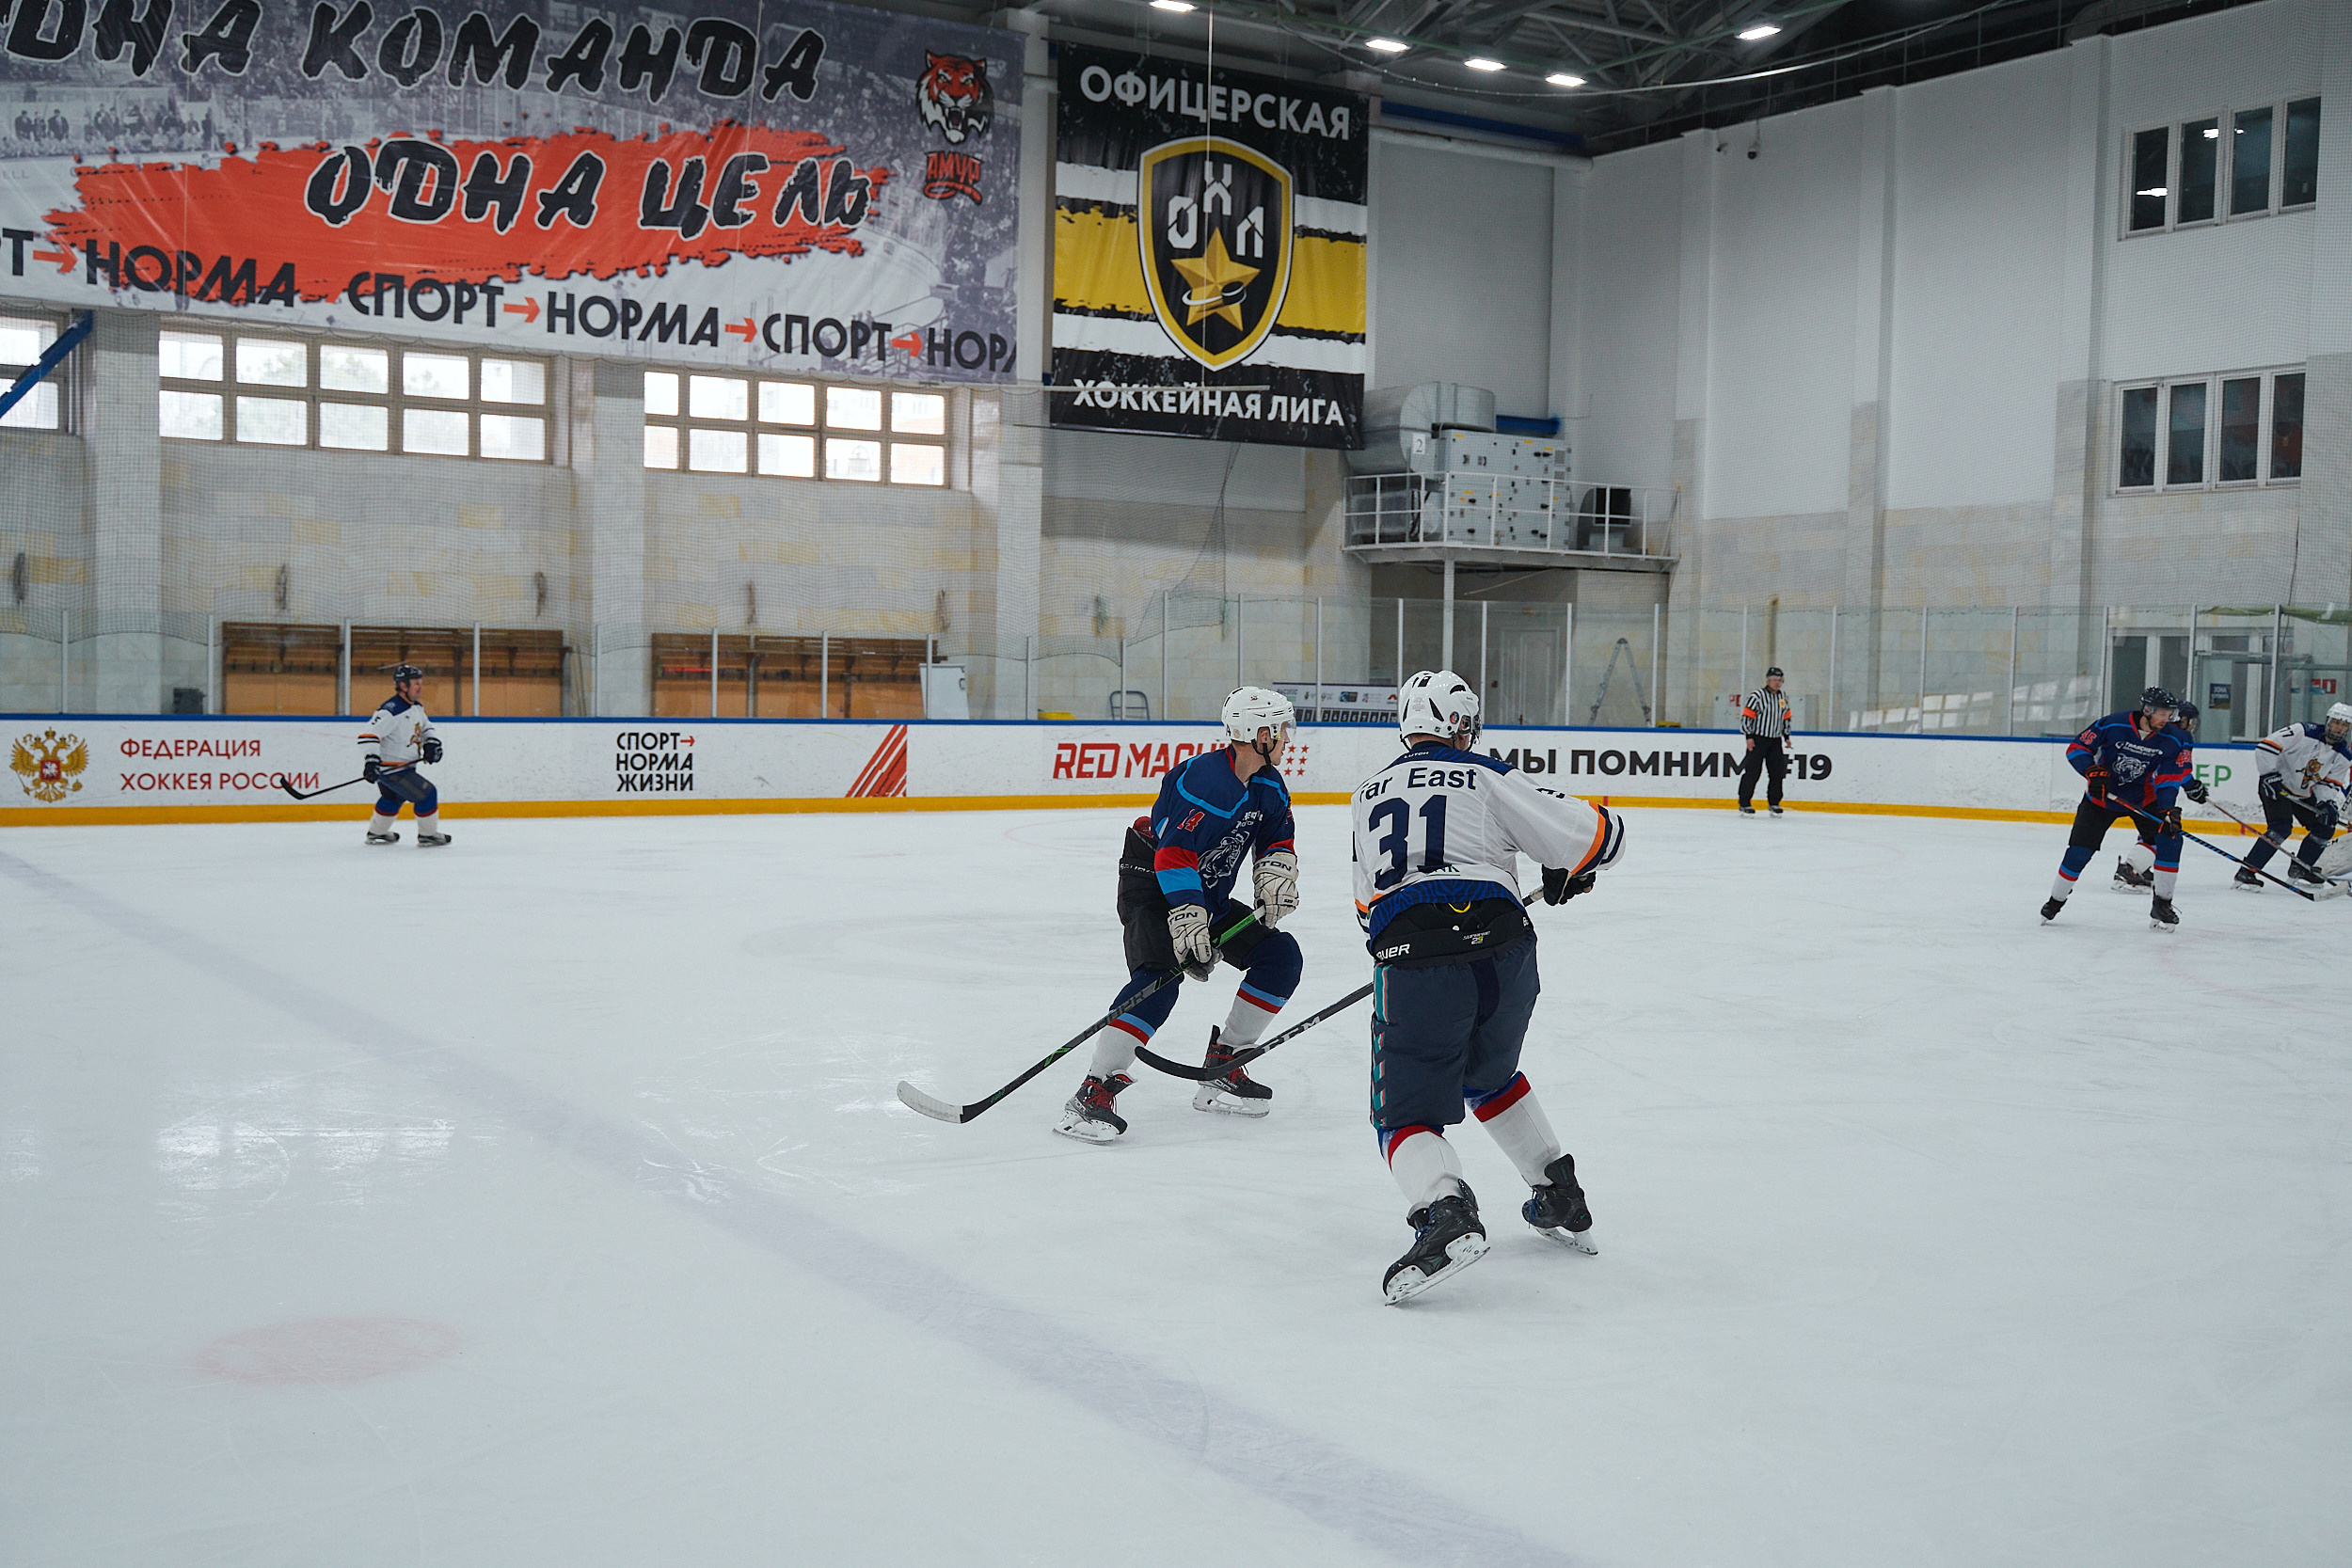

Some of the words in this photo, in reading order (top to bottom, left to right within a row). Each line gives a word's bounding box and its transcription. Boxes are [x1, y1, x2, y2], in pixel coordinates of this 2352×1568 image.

[302, 0, 827, 103] КОМАНДА
[1080, 65, 1351, 140] ОФИЦЕРСКАЯ
[925, 150, 983, 186] АМУР
[304, 138, 608, 234] ОДНА
[640, 151, 872, 241] ЦЕЛЬ
[0, 228, 34, 277] Т
[86, 239, 296, 308] НОРМА
[347, 272, 503, 327] СПОРТ
[547, 292, 719, 347] НОРМА
[762, 313, 892, 361] СПОРТ
[1073, 378, 1262, 420] ХОККЕЙНАЯ
[1269, 393, 1345, 427] ЛИГА
[1415, 438, 1423, 452] 2
[120, 738, 261, 759] ФЕДЕРАЦИЯ
[616, 732, 679, 751] СПОРТ
[2080, 729, 2098, 745] 45
[616, 752, 693, 771] НОРМА
[1053, 742, 1120, 779] RED
[1489, 748, 1556, 774] МЫ
[1571, 749, 1747, 778] ПОМНИМ
[120, 772, 212, 791] ХОККЕЯ
[219, 771, 319, 790] РОССИИ
[616, 773, 693, 792] ЖИЗНИ
[1407, 767, 1477, 791] East
[2195, 764, 2233, 787] ЕР
[1368, 794, 1452, 892] 31
[1253, 861, 1293, 872] STON
[1375, 942, 1411, 961] AUER
